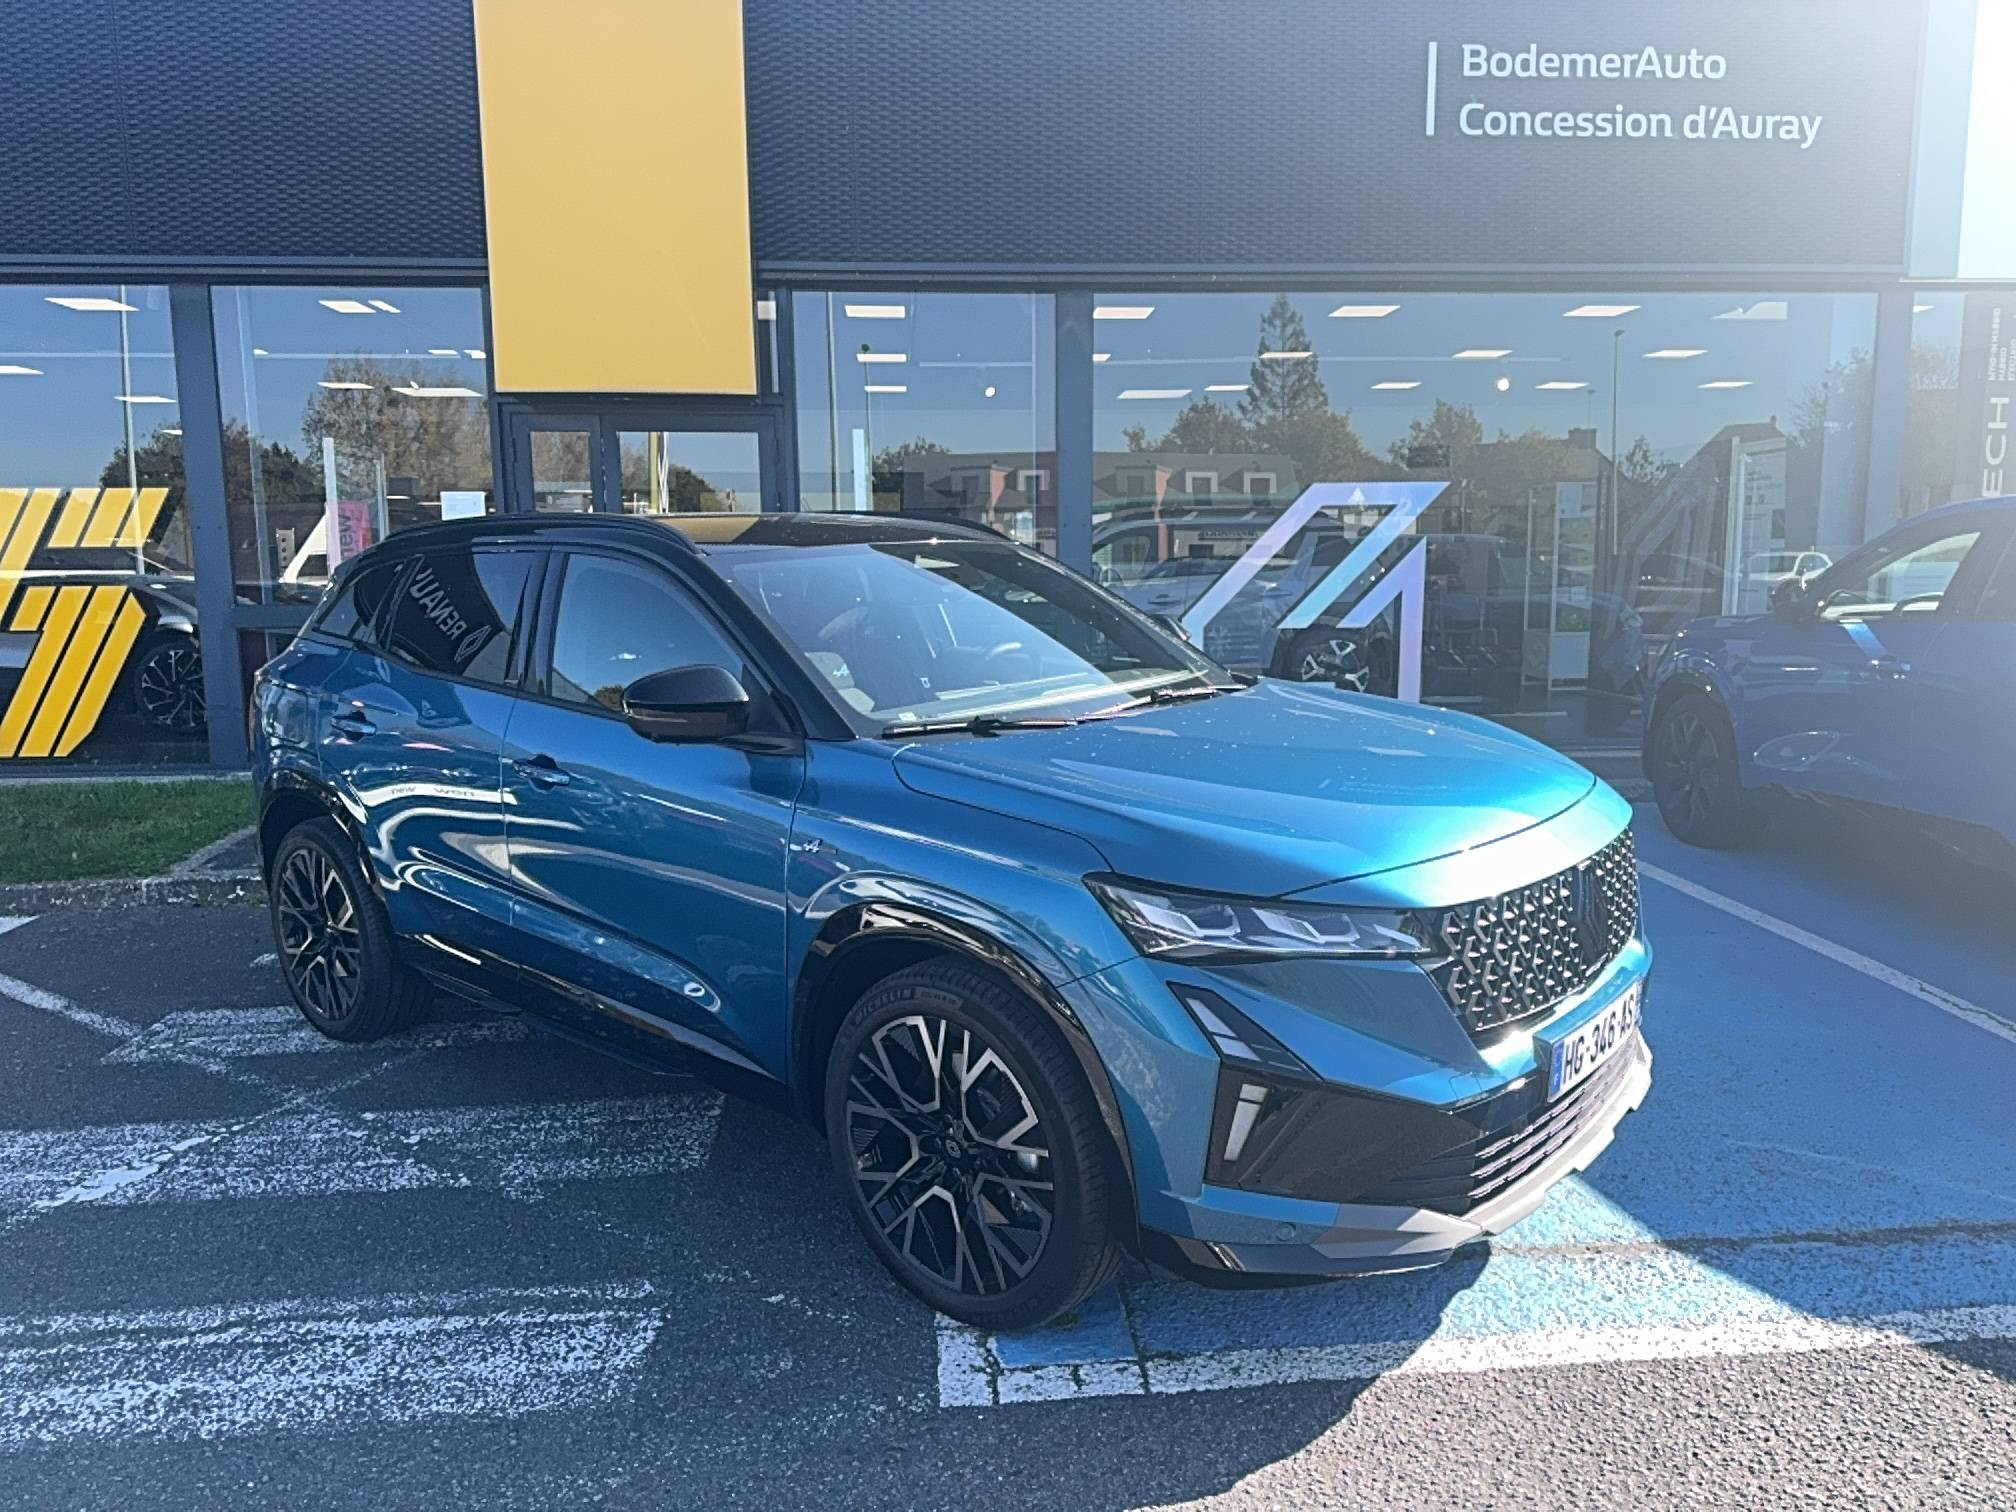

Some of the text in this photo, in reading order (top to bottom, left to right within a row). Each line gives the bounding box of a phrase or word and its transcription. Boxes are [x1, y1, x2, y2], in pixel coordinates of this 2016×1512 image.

[1461, 43, 1727, 79] BodemerAuto
[1458, 103, 1822, 149] Concession d'Auray
[1563, 993, 1635, 1084] HG-346-AS
